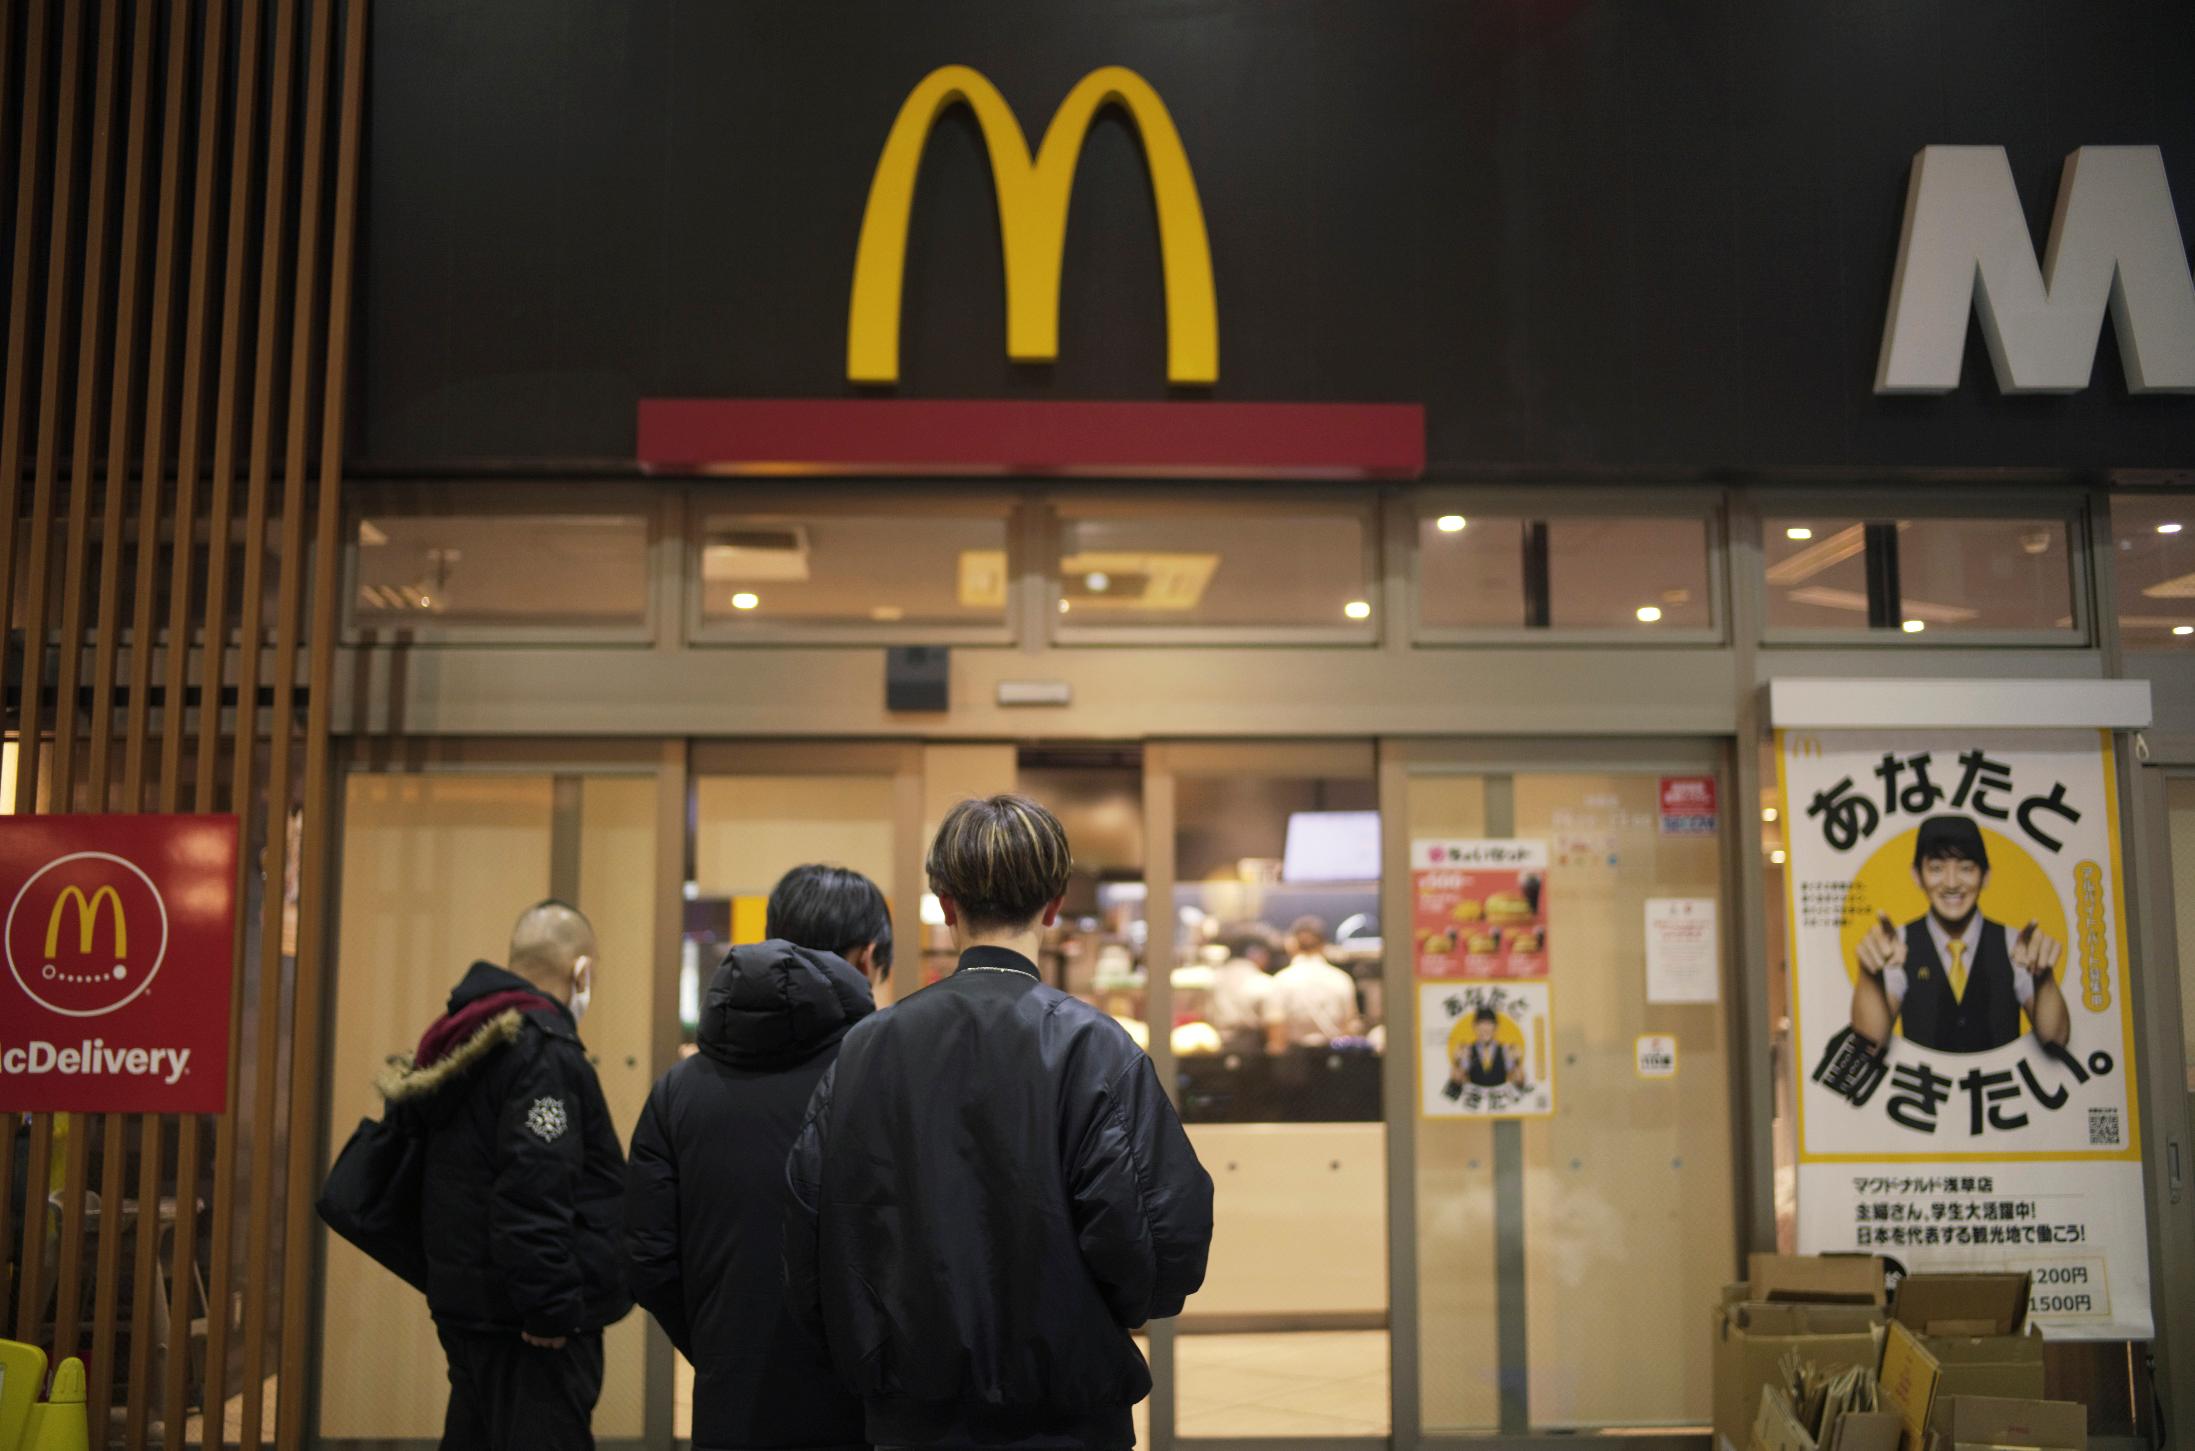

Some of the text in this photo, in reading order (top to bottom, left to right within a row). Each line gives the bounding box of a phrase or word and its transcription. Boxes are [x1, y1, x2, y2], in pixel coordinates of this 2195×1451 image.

[1807, 748, 2082, 854] あなたと
[0, 1038, 190, 1085] cDelivery
[1854, 1176, 1993, 1193] マクドナルド浅草店
[1857, 1224, 2085, 1245] 日本を代表する観光地で働こう!
[2031, 1266, 2088, 1284] 200円
[2029, 1294, 2091, 1312] 1500円
